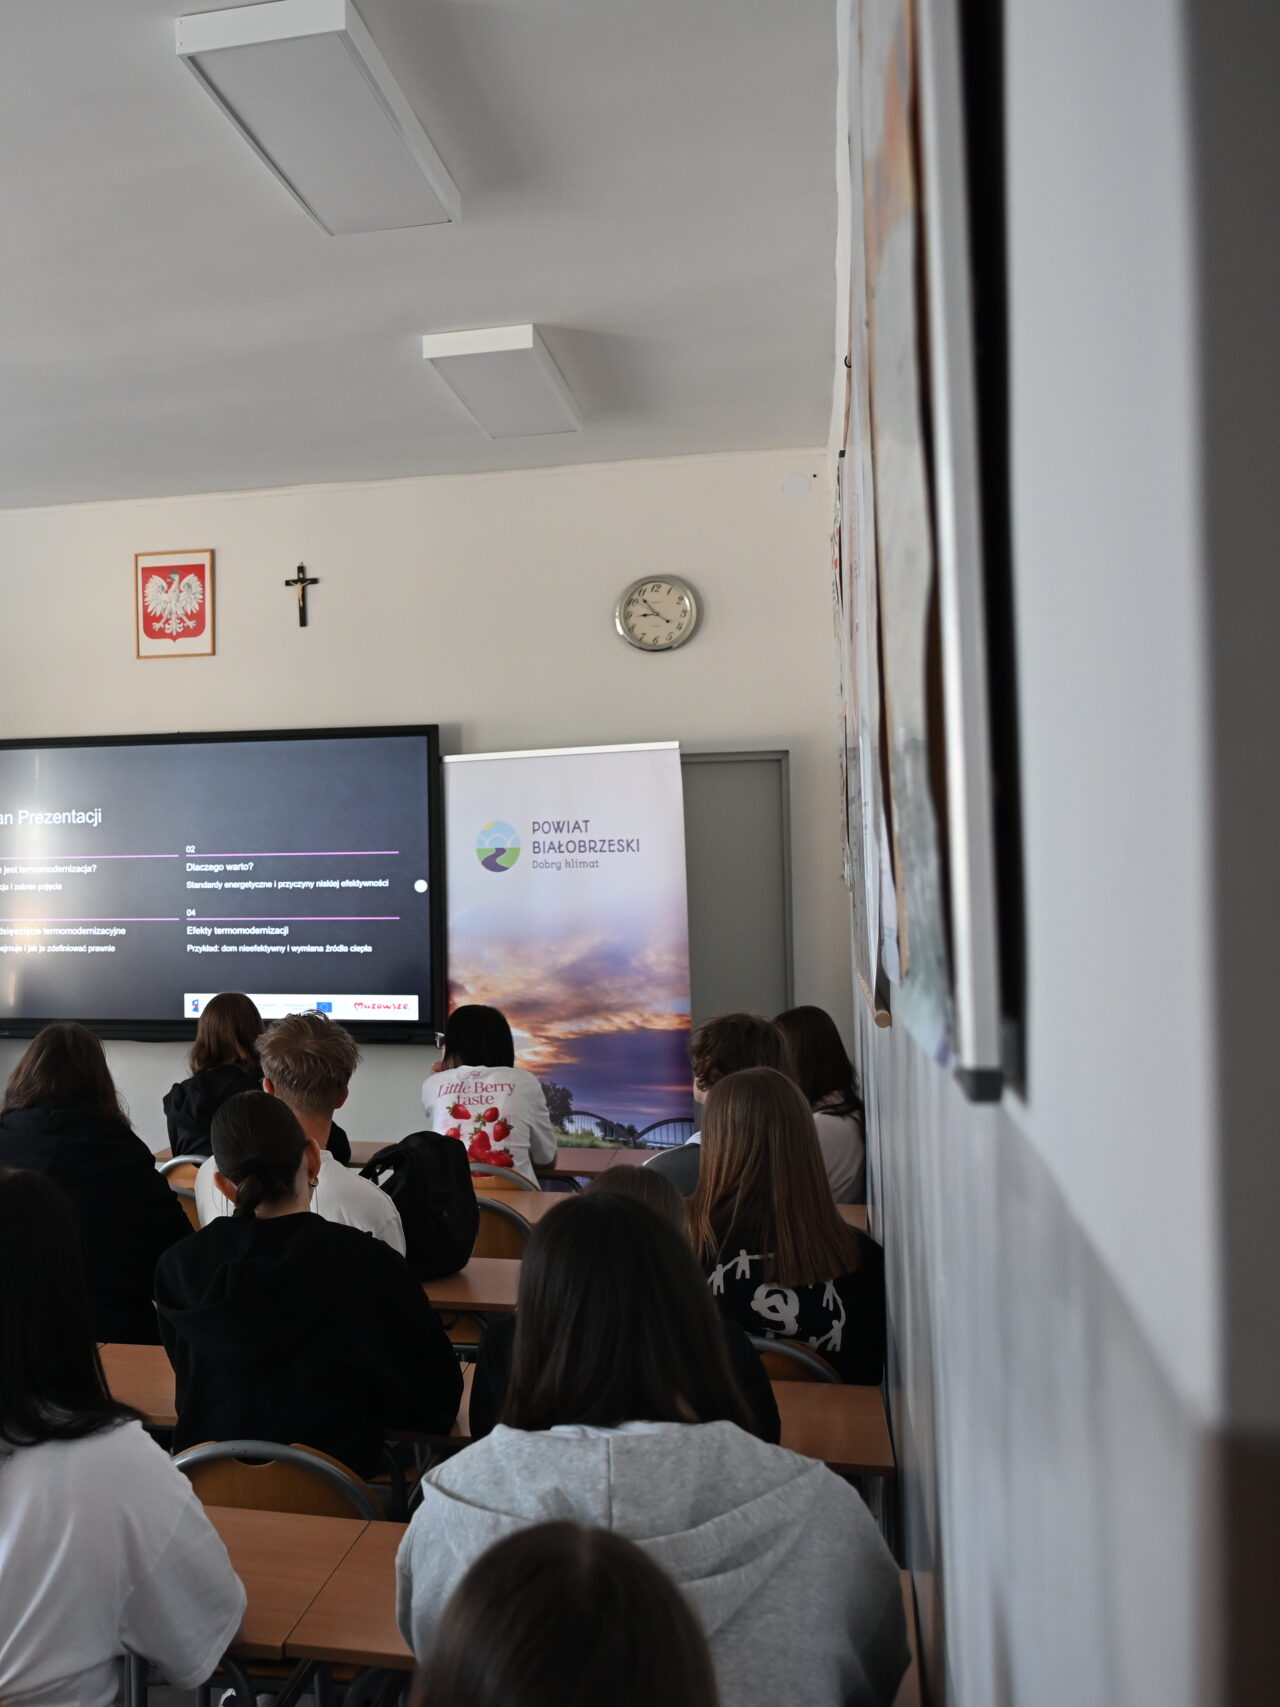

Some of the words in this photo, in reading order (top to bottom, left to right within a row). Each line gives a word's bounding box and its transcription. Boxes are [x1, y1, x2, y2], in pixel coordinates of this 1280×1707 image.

[638, 587, 647, 596] 11
[650, 584, 662, 592] 12
[667, 587, 672, 596] 1
[628, 598, 639, 606] 10
[676, 596, 684, 604] 2
[680, 609, 687, 618] 3
[676, 622, 683, 630] 4
[639, 633, 646, 641] 7
[652, 636, 660, 645] 6
[666, 632, 673, 641] 5
[18, 808, 102, 827] Prezentacji
[532, 819, 590, 834] POWIAT
[186, 845, 196, 853] 02
[532, 838, 640, 854] BIAŁOBRZESKI
[186, 863, 224, 873] Dlaczego
[226, 862, 254, 872] warto?
[532, 859, 562, 870] Dobry
[564, 858, 599, 869] klimat
[3, 865, 18, 876] jest
[19, 864, 97, 875] termomodernizacja?
[186, 881, 222, 890] Standardy
[224, 881, 272, 890] energetyczne
[278, 881, 314, 889] przyczyny
[316, 880, 339, 889] niskiej
[341, 879, 389, 888] efektywności
[43, 927, 126, 936] termomodernizacyjne
[187, 927, 212, 936] Efekty
[214, 926, 289, 936] termomodernizacji
[46, 944, 87, 953] zdefiniować
[88, 945, 115, 953] prawnie
[187, 945, 219, 953] Przykład:
[239, 945, 285, 953] nieefektywny
[291, 945, 324, 953] wymiana
[325, 944, 348, 952] źródła
[437, 1081, 471, 1098] Little
[474, 1082, 515, 1096] Berry
[456, 1095, 495, 1106] taste
